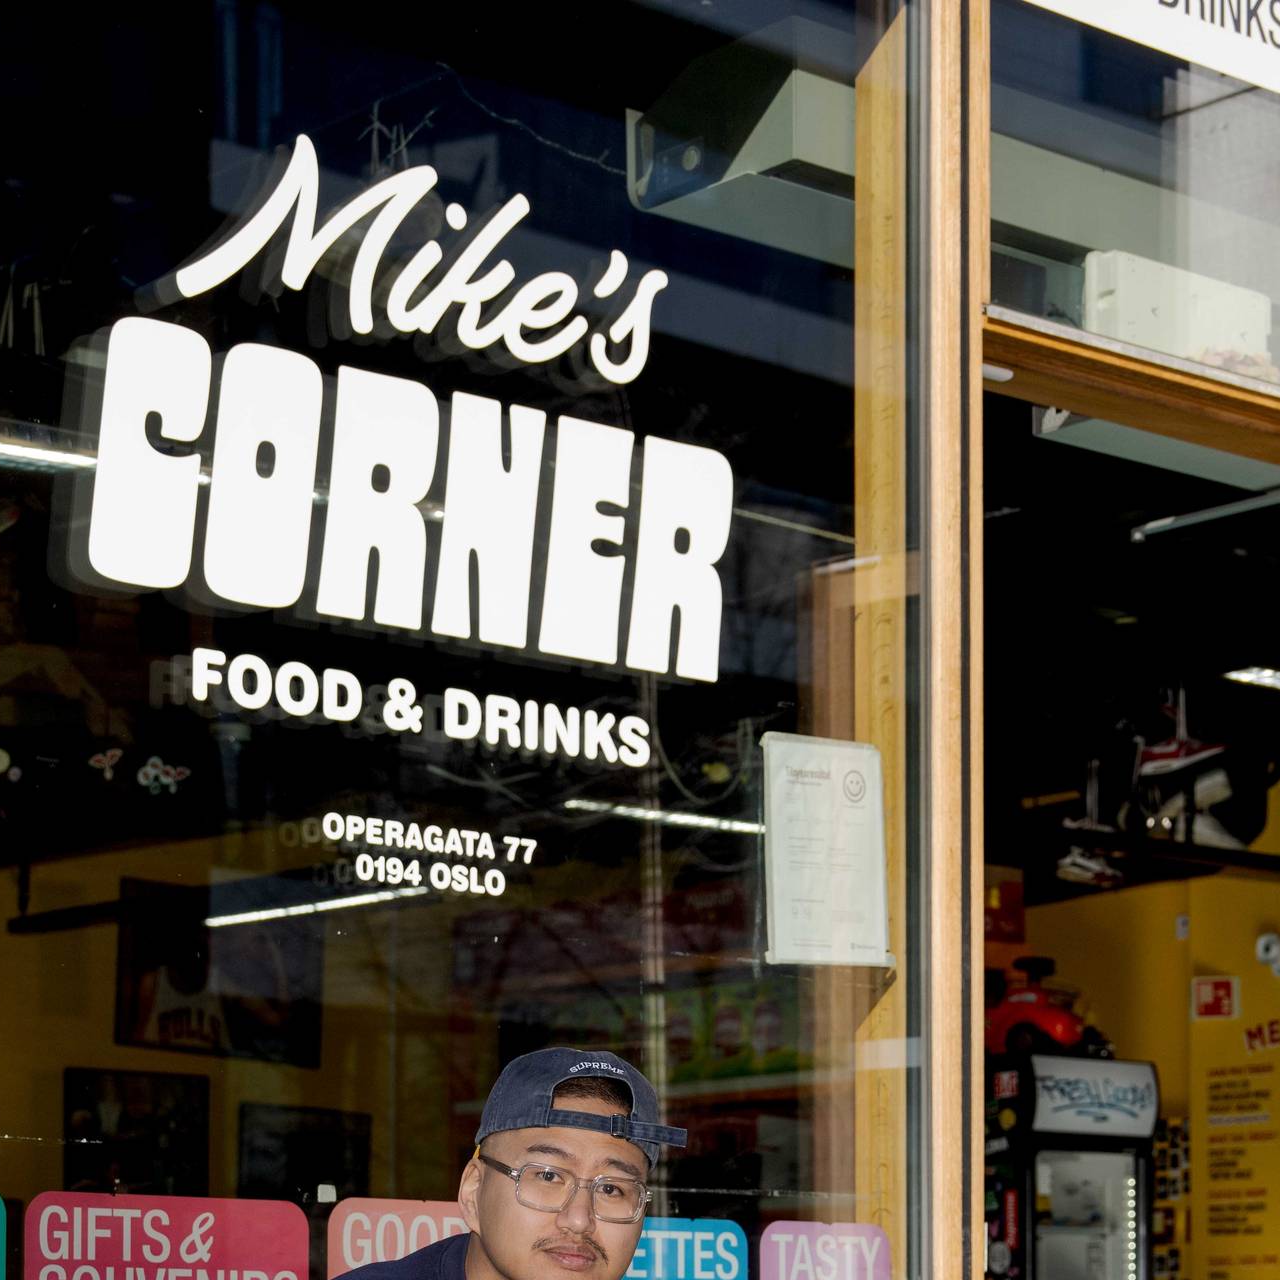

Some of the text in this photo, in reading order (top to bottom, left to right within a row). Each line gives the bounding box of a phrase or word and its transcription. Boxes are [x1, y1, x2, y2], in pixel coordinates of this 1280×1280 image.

[176, 133, 669, 385] Mike's
[88, 316, 735, 683] CORNER
[191, 646, 652, 768] FOOD & DRINKS
[322, 811, 538, 864] OPERAGATA 77
[355, 853, 507, 897] 0194 OSLO
[569, 1061, 625, 1075] SUPREME
[39, 1205, 215, 1264] GIFTS &
[342, 1211, 471, 1270] GOO
